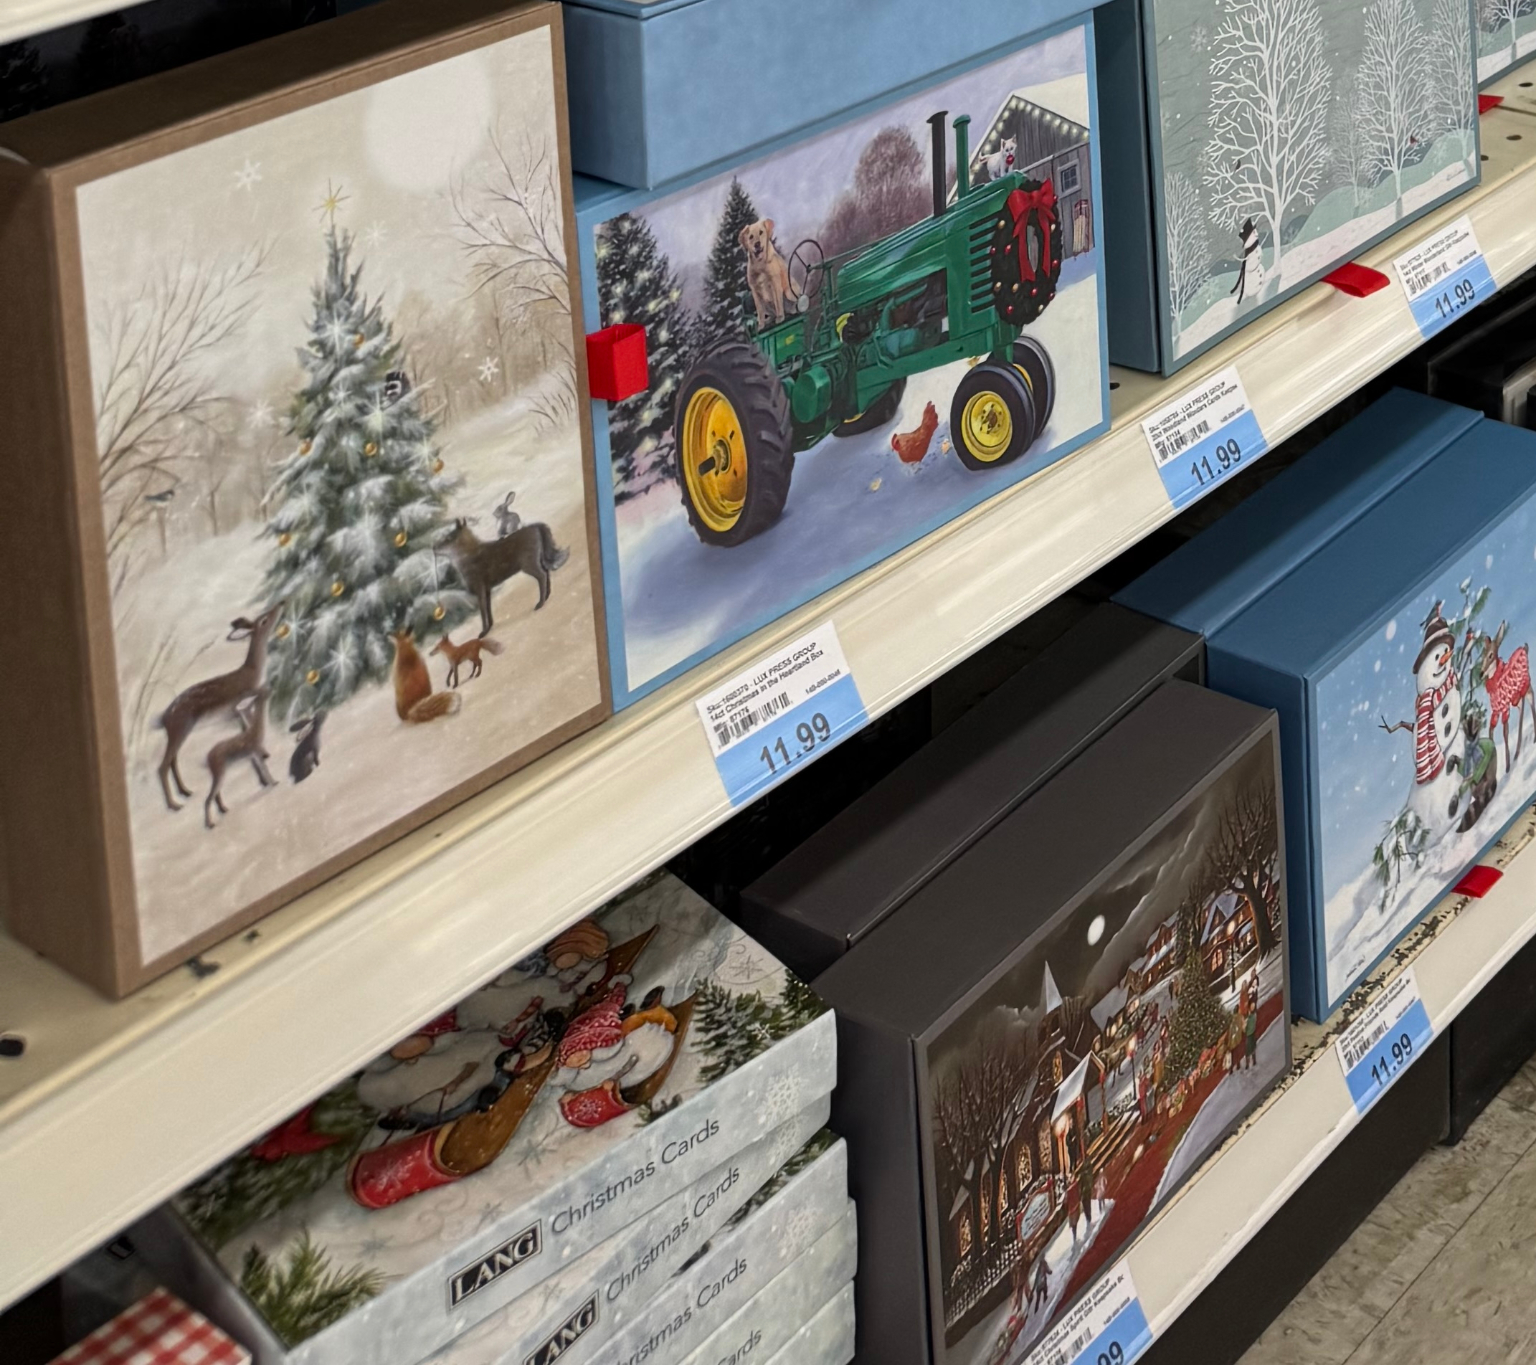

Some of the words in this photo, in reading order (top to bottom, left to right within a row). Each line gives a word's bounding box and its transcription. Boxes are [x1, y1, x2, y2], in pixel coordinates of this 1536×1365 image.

[1435, 278, 1476, 319] 11.99
[1191, 438, 1242, 486] 11.99
[724, 686, 760, 714] Christmas
[766, 674, 780, 688] the
[778, 655, 811, 681] Heartland
[810, 647, 824, 662] Box
[751, 670, 768, 686] LUX
[767, 656, 793, 677] PRESS
[791, 641, 818, 662] GROUP
[760, 712, 832, 775] 11.99
[1371, 1032, 1413, 1086] 11.99
[451, 1223, 540, 1305] LANG
[550, 1162, 656, 1236] Christmas
[660, 1117, 720, 1165] Cards
[527, 1297, 596, 1365] LANG
[606, 1214, 690, 1304] Christmas
[692, 1165, 741, 1219] Cards
[612, 1303, 692, 1365] hristmas
[696, 1255, 748, 1308] Cards
